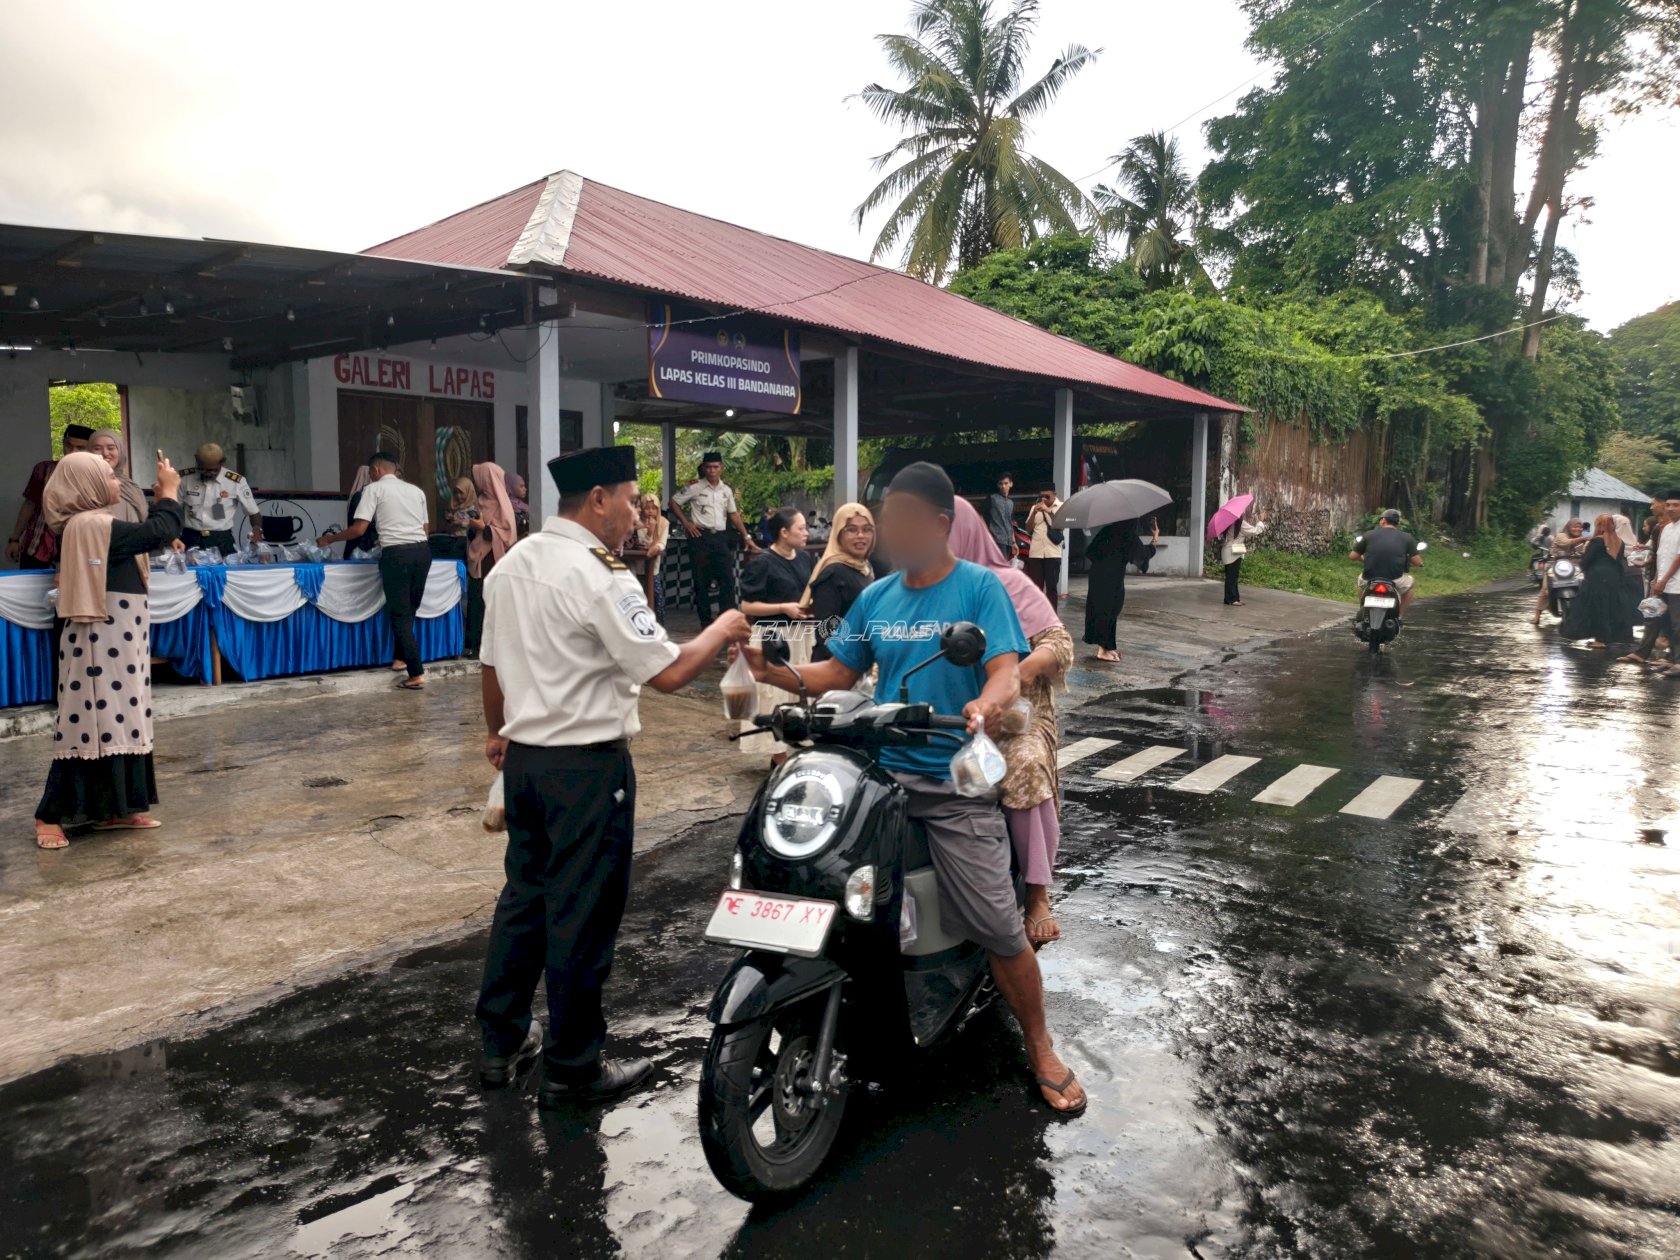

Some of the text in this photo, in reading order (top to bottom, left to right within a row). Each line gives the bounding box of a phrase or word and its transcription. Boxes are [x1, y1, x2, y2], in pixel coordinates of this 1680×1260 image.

[334, 353, 495, 399] GALERI LAPAS
[690, 349, 771, 375] PRIMKOPASINDO
[660, 366, 796, 398] LAPAS KELAS III BANDANAIRA
[750, 901, 795, 921] 3867
[799, 905, 828, 924] XY
